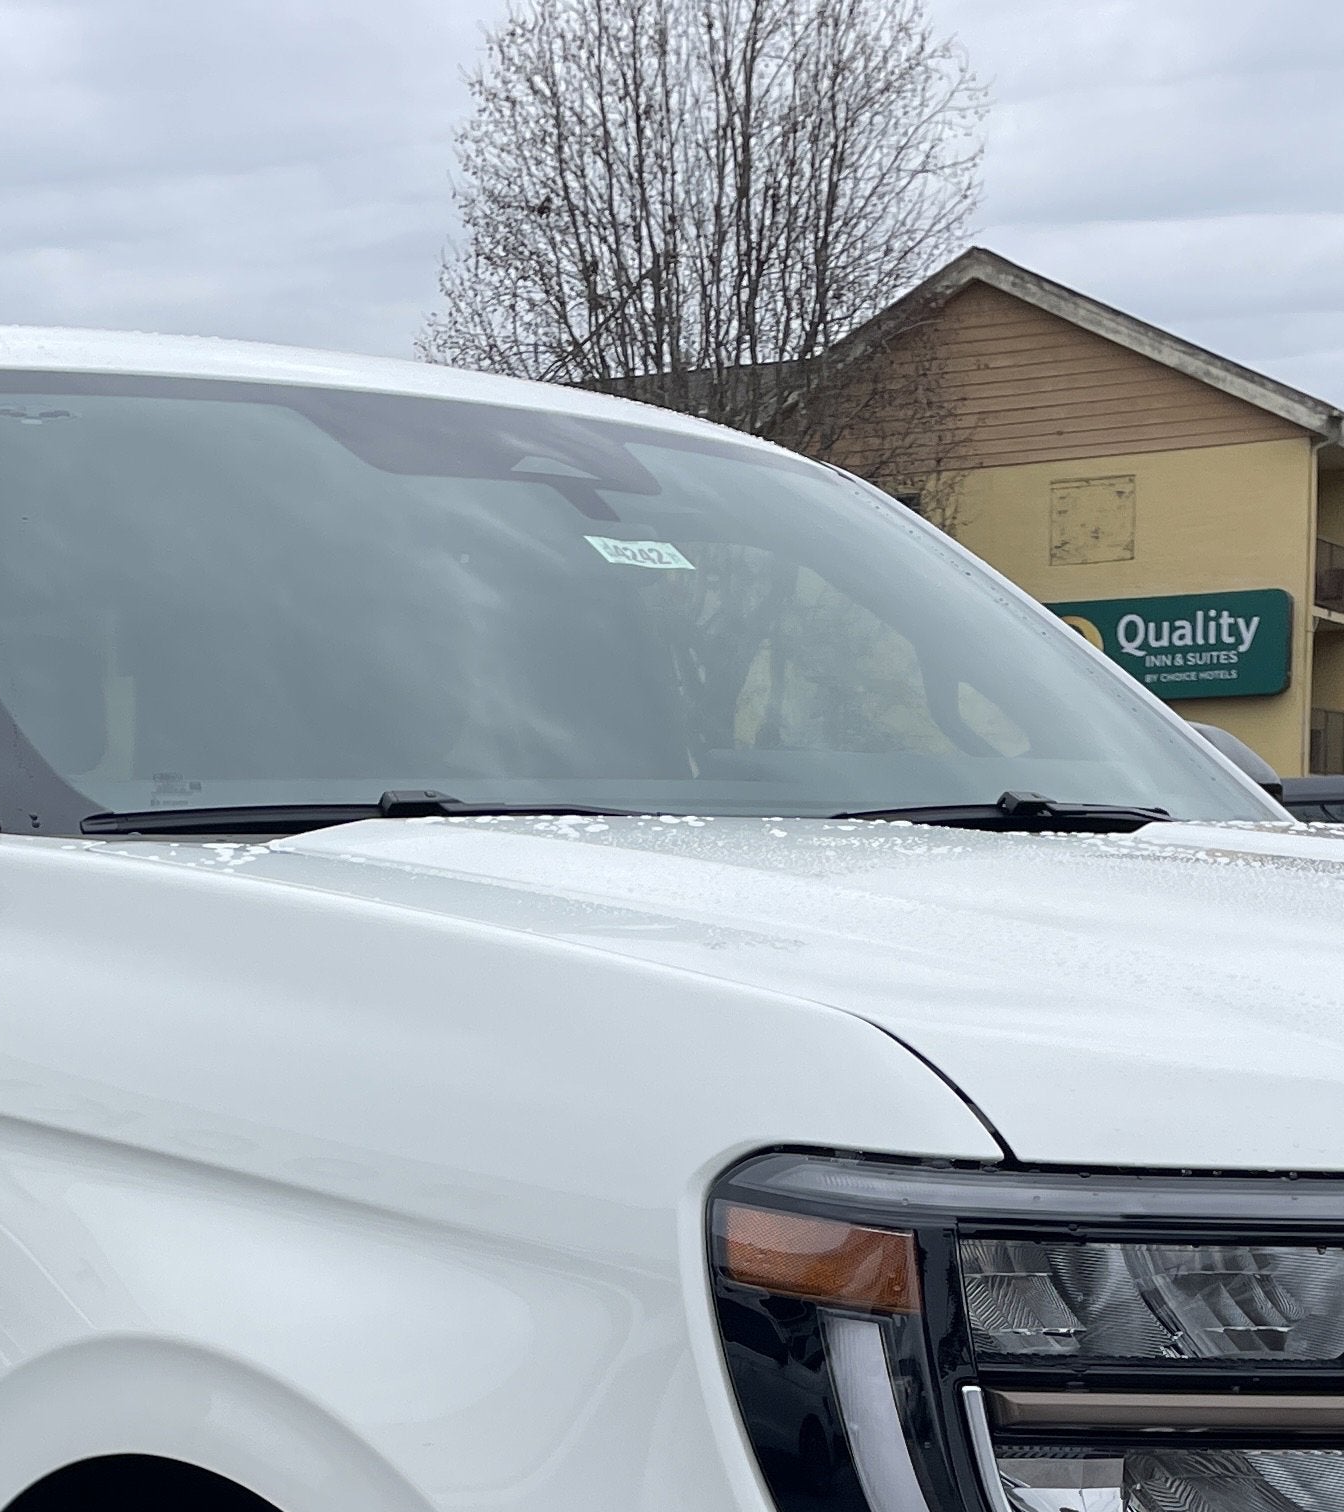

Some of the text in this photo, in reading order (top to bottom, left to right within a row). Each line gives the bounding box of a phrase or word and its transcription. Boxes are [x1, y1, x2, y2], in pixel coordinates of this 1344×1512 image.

[1117, 609, 1260, 657] Quality
[1145, 650, 1238, 667] INN & SUITES
[1159, 671, 1197, 682] CHOICE
[1199, 669, 1238, 680] HOTELS
